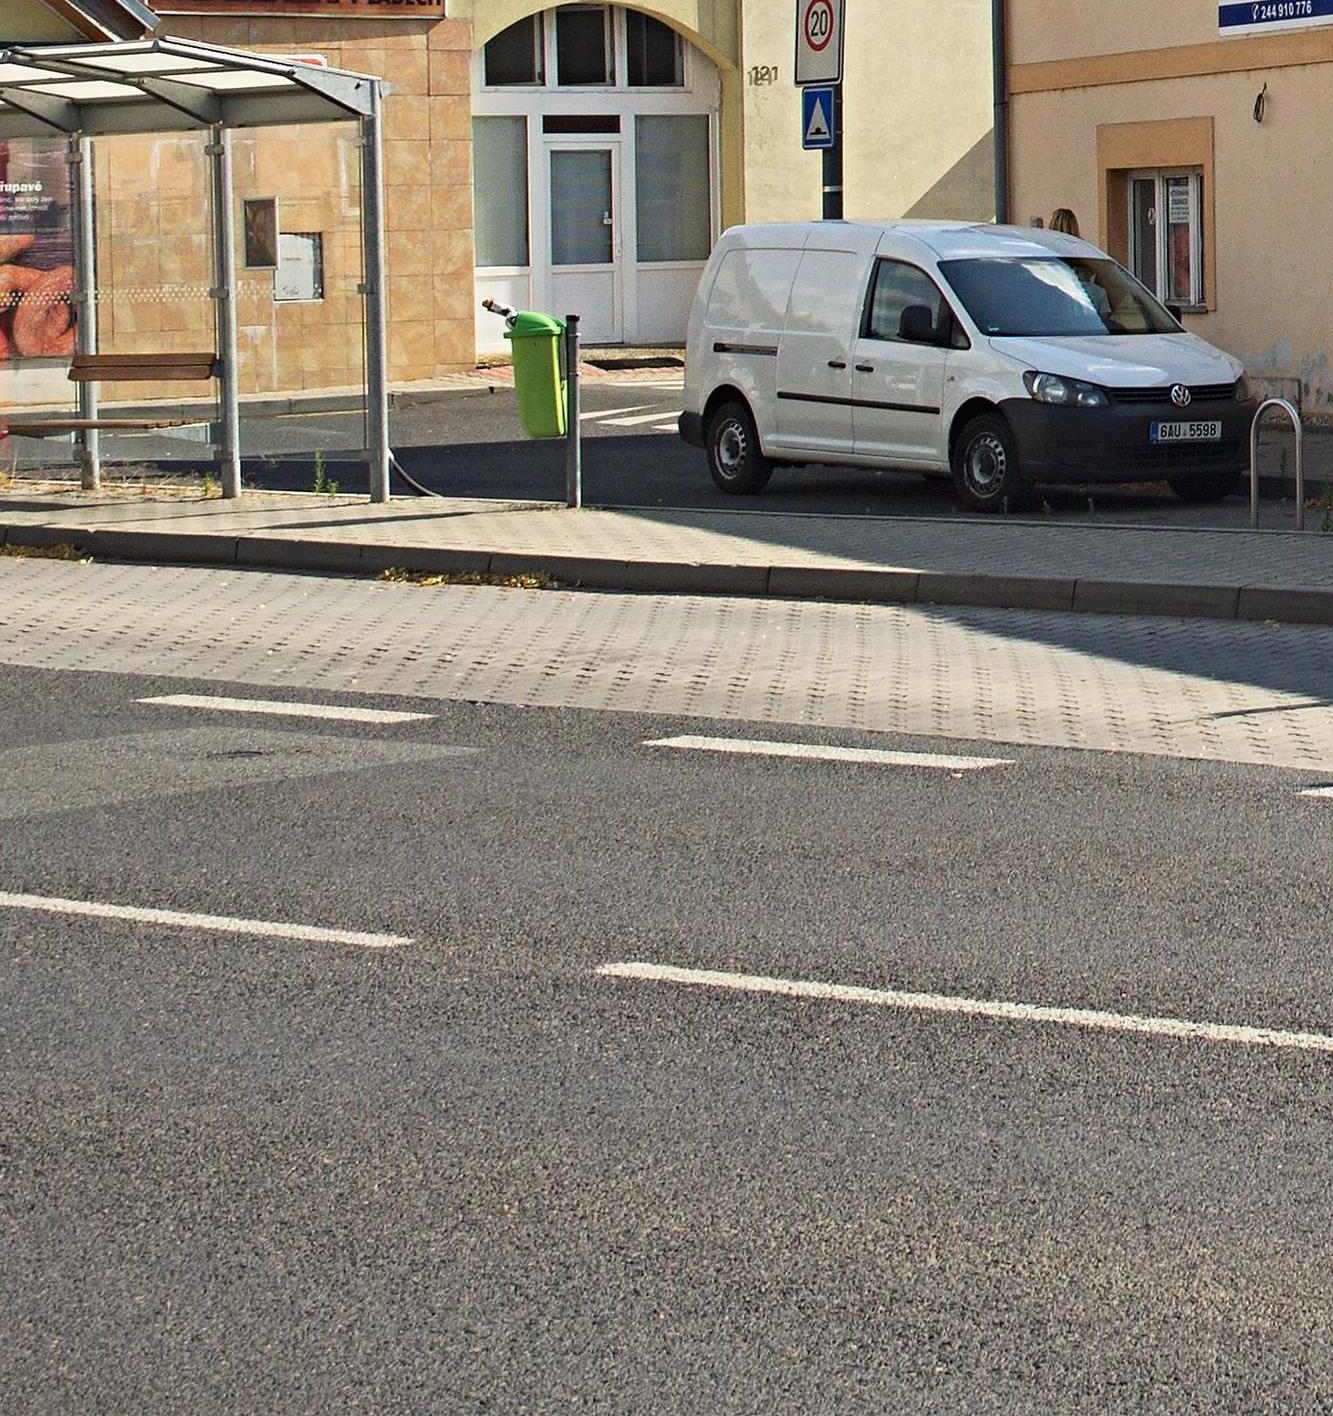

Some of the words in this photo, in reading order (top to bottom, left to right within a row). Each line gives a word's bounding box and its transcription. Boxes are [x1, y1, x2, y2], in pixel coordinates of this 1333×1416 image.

[1261, 4, 1277, 20] 244
[1278, 2, 1294, 18] 910
[1296, 0, 1312, 15] 776
[810, 8, 829, 37] 20
[752, 65, 778, 81] 121
[1160, 424, 1181, 438] 6AU
[1189, 423, 1216, 437] 5598
